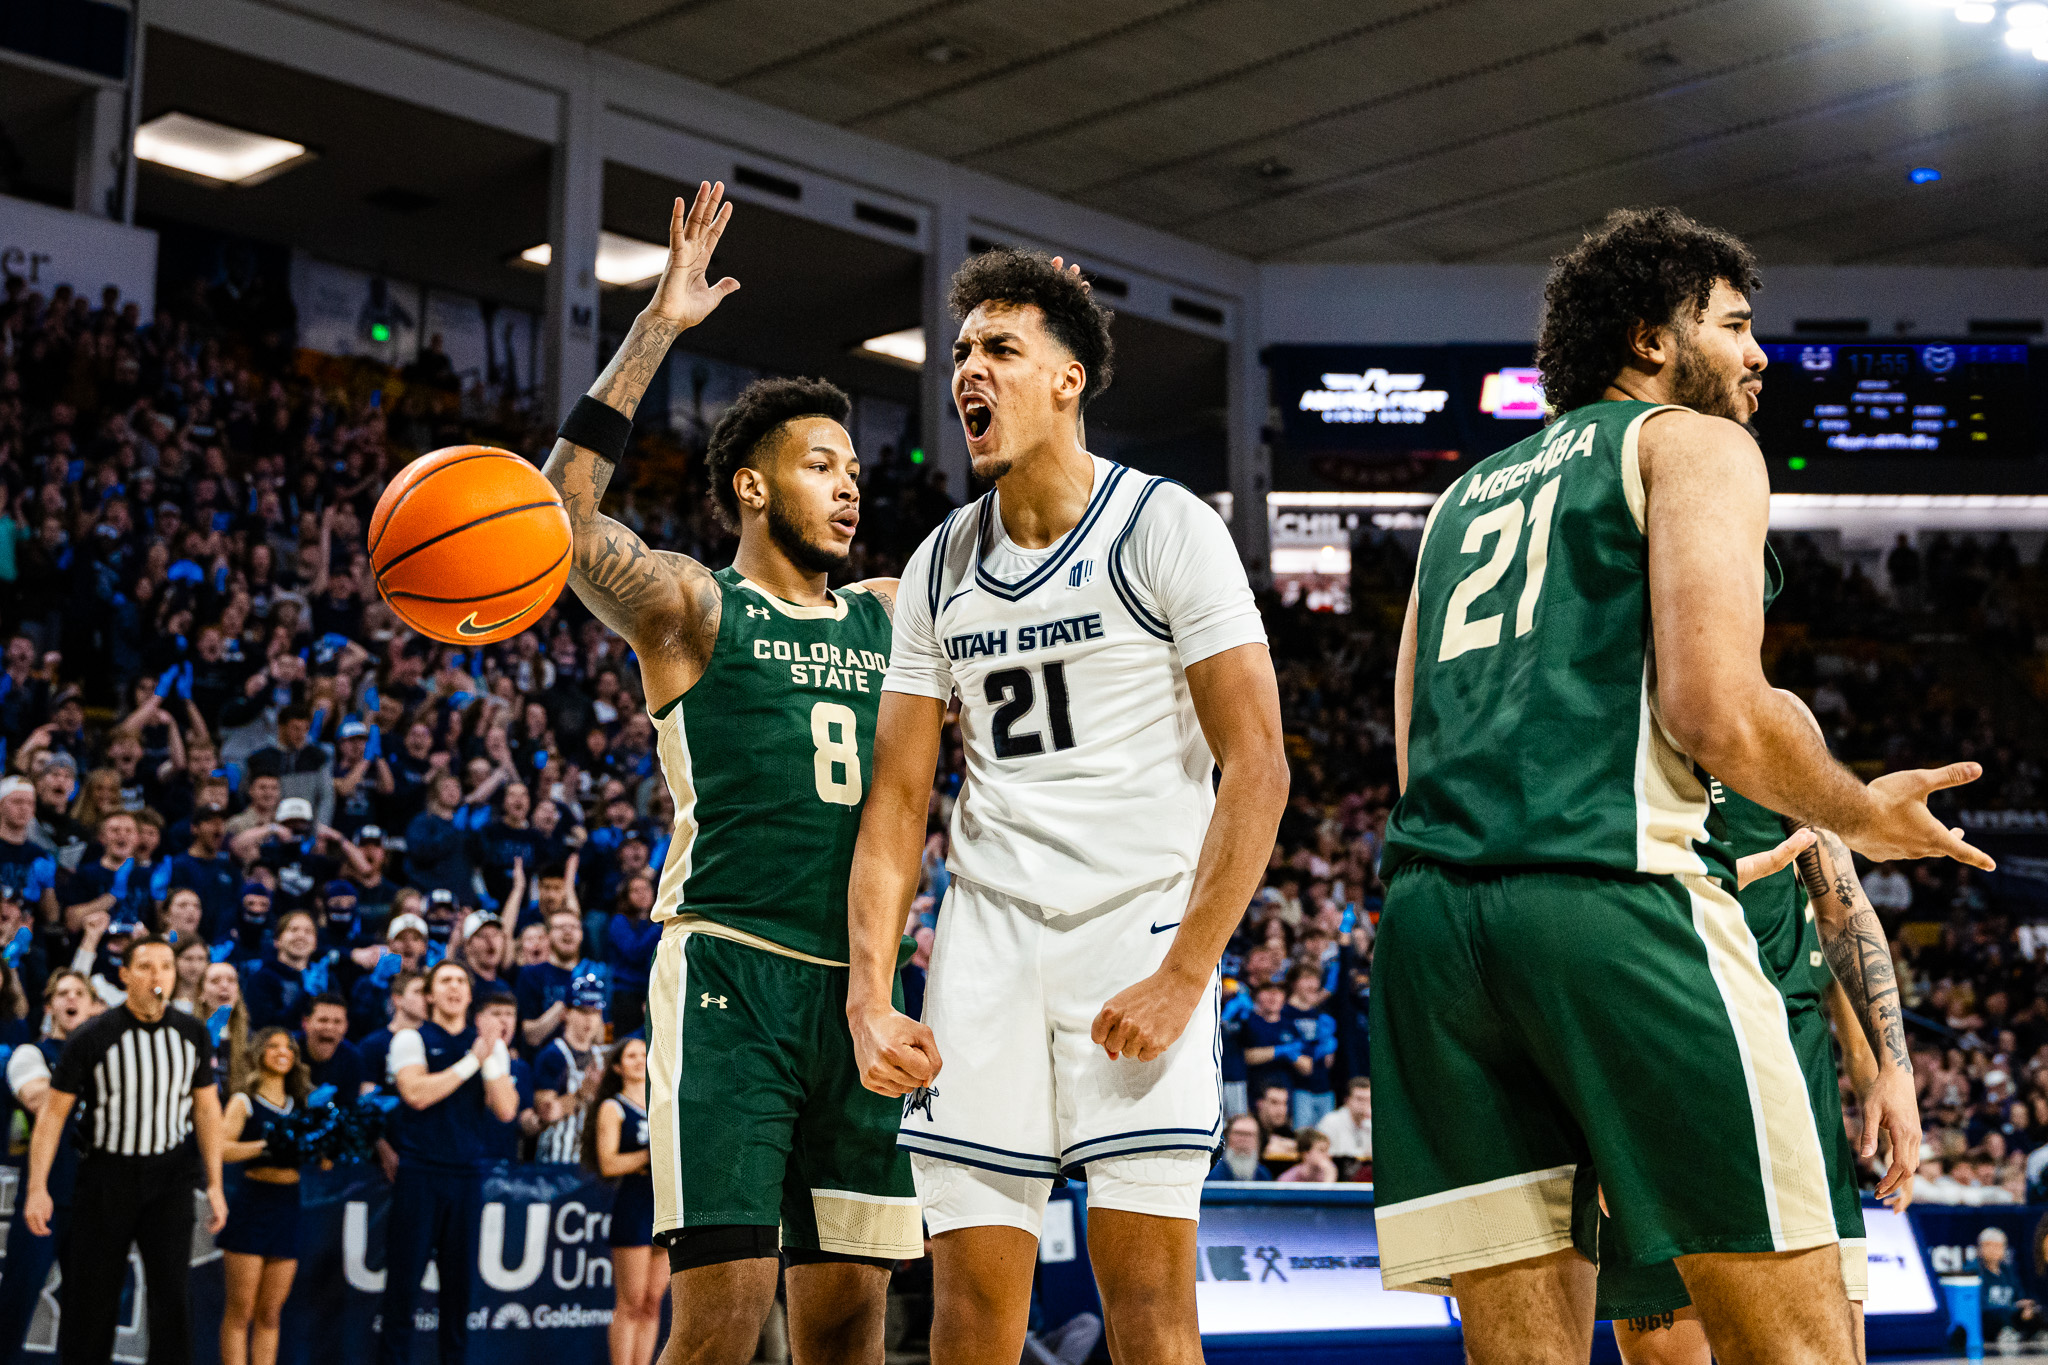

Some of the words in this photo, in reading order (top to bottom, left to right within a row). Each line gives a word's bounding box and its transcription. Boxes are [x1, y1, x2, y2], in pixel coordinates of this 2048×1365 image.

[1459, 423, 1597, 506] MBEMBA
[1438, 474, 1562, 662] 21
[753, 639, 887, 675] COLORADO
[944, 629, 1008, 661] UTAH
[1018, 612, 1106, 653] STATE
[790, 664, 870, 693] STATE
[983, 660, 1077, 760] 21
[810, 701, 862, 806] 8
[466, 1306, 489, 1331] of
